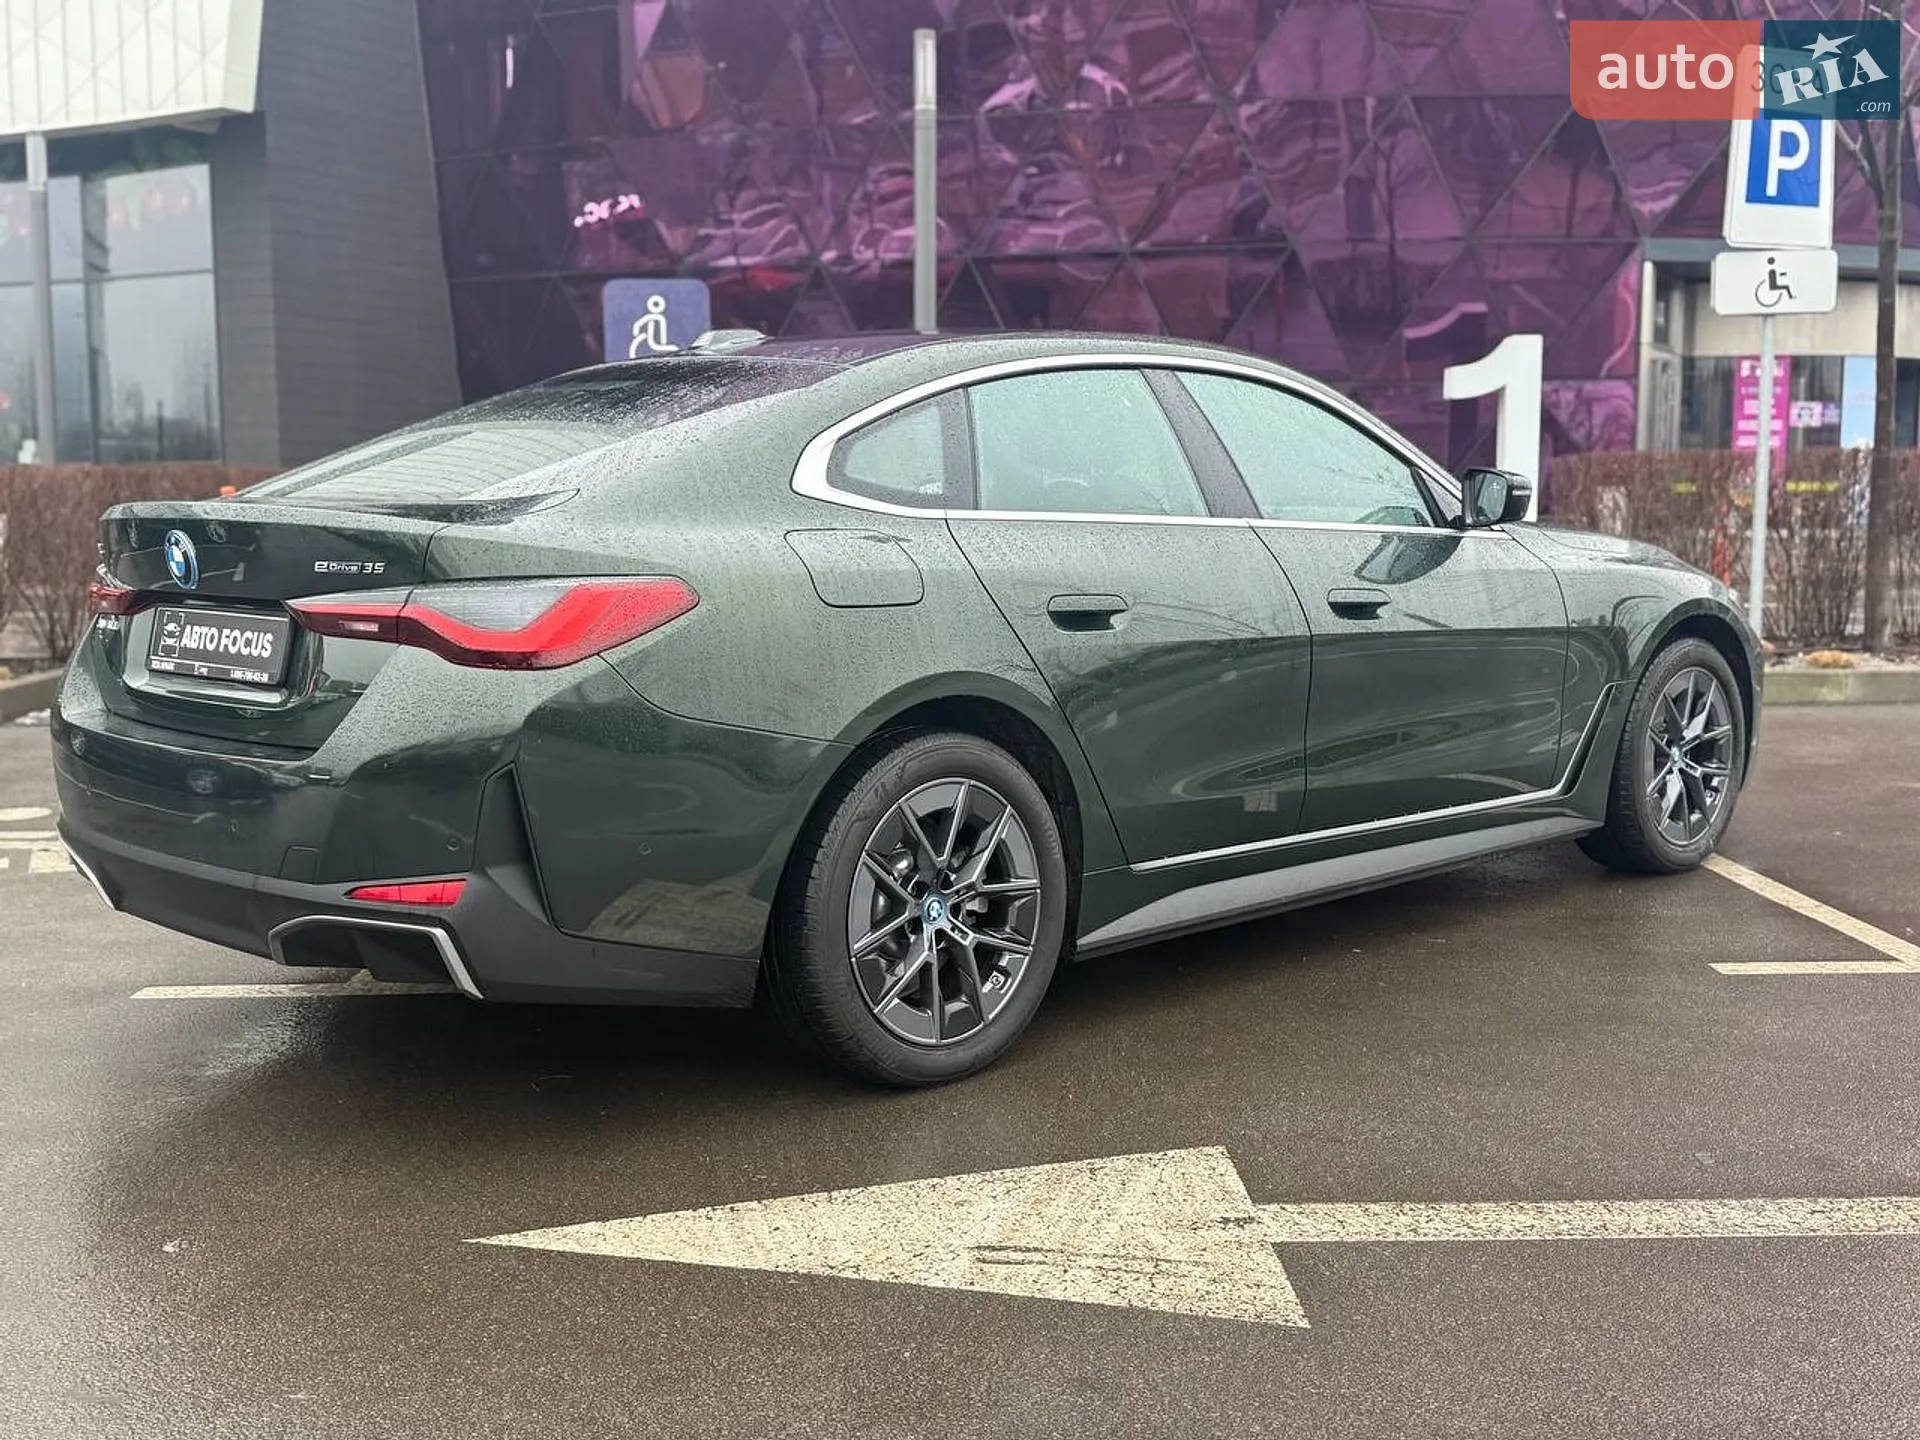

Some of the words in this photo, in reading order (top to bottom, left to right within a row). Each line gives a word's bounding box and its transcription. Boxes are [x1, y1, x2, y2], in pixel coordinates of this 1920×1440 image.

[1766, 118, 1810, 197] P
[1443, 334, 1544, 522] 1
[219, 628, 274, 658] FOCUS
